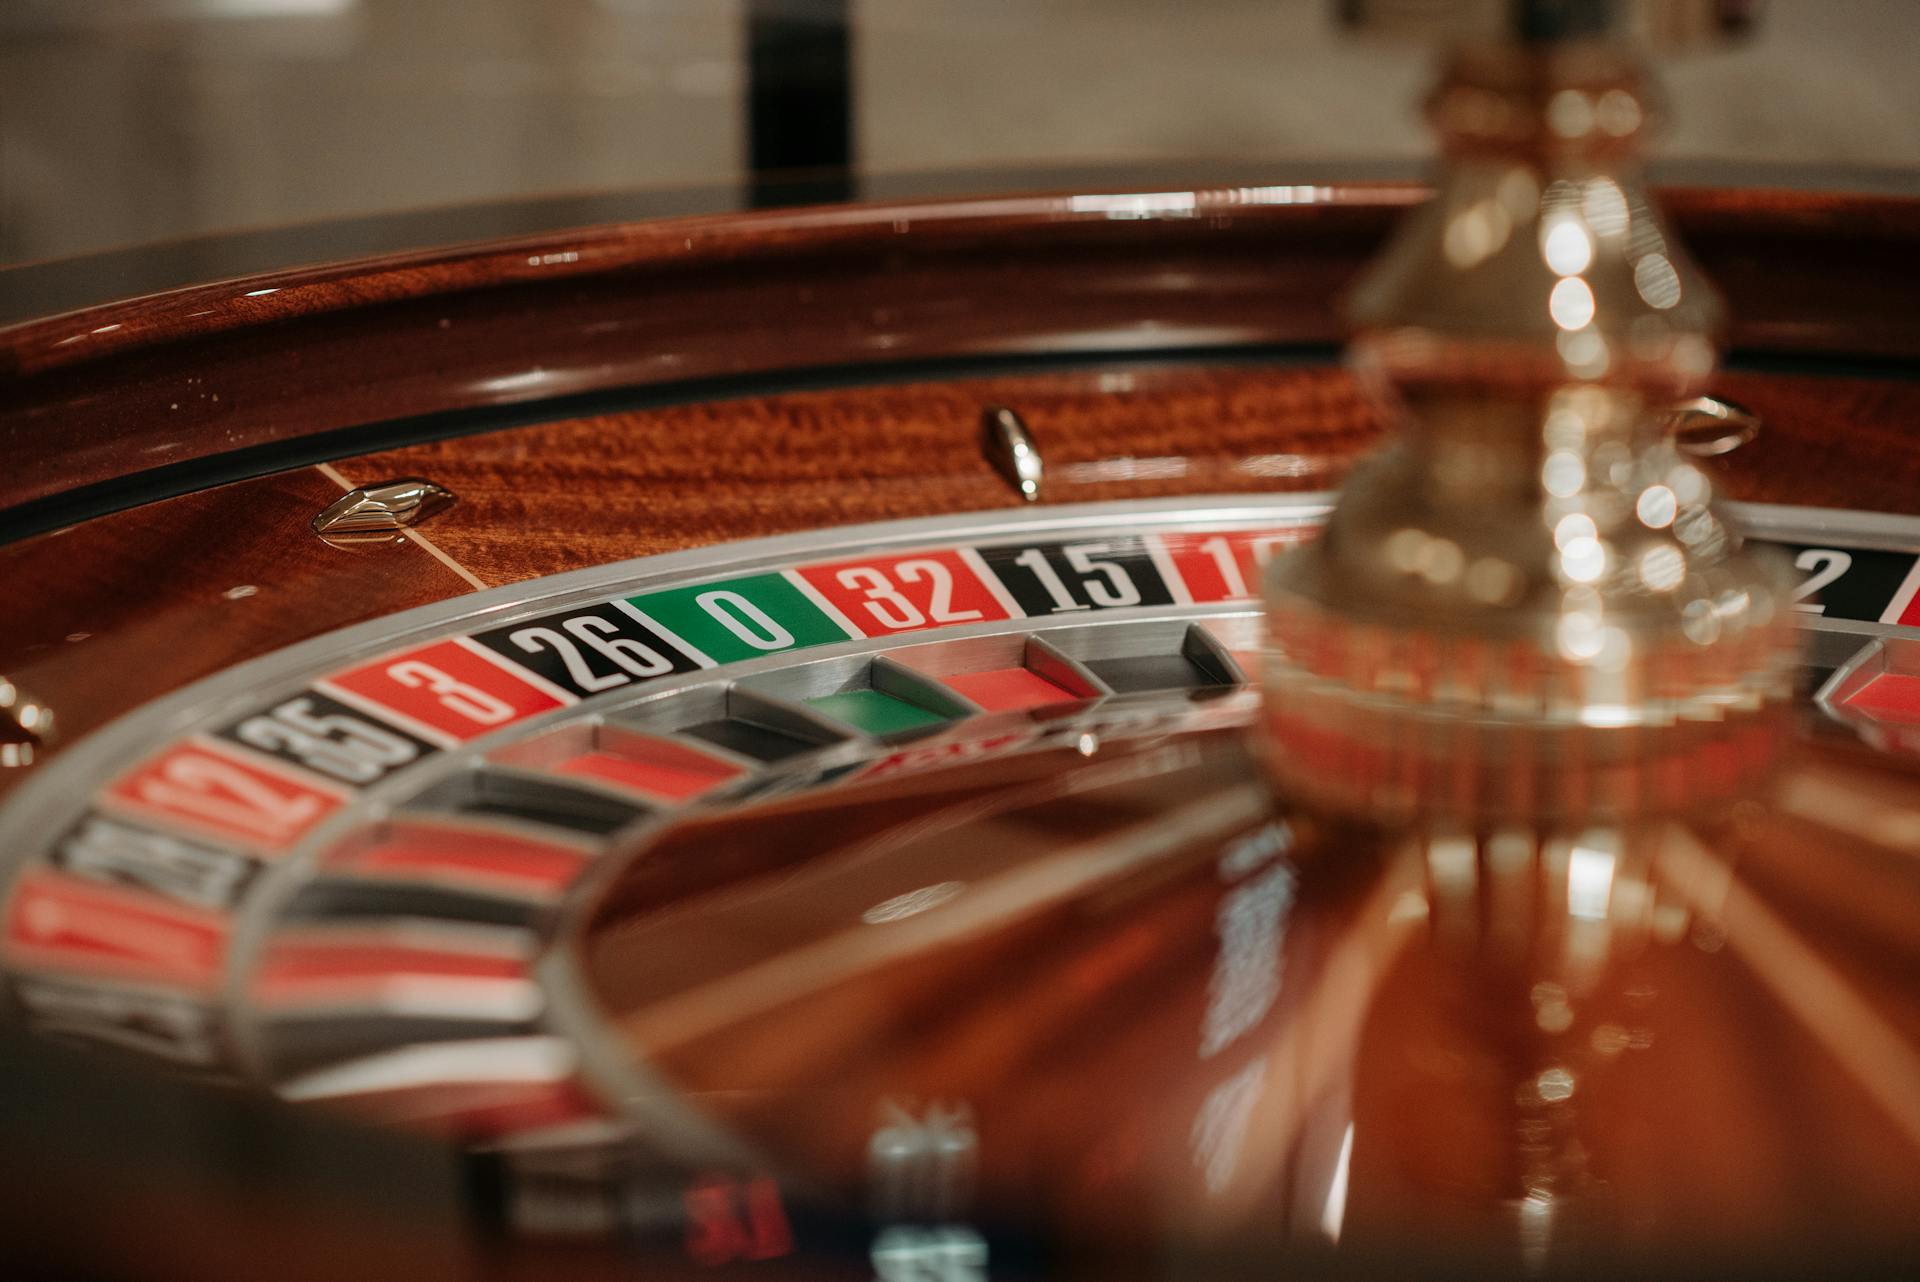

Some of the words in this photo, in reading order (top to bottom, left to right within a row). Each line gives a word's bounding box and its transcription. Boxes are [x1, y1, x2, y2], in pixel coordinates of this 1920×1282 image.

[835, 558, 983, 630] 32
[1014, 542, 1142, 612] 15
[1199, 535, 1299, 600] 1
[1793, 548, 1853, 614] 2
[508, 615, 675, 693] 26
[694, 589, 796, 651] 0
[387, 660, 516, 725] 3
[236, 698, 418, 784] 35
